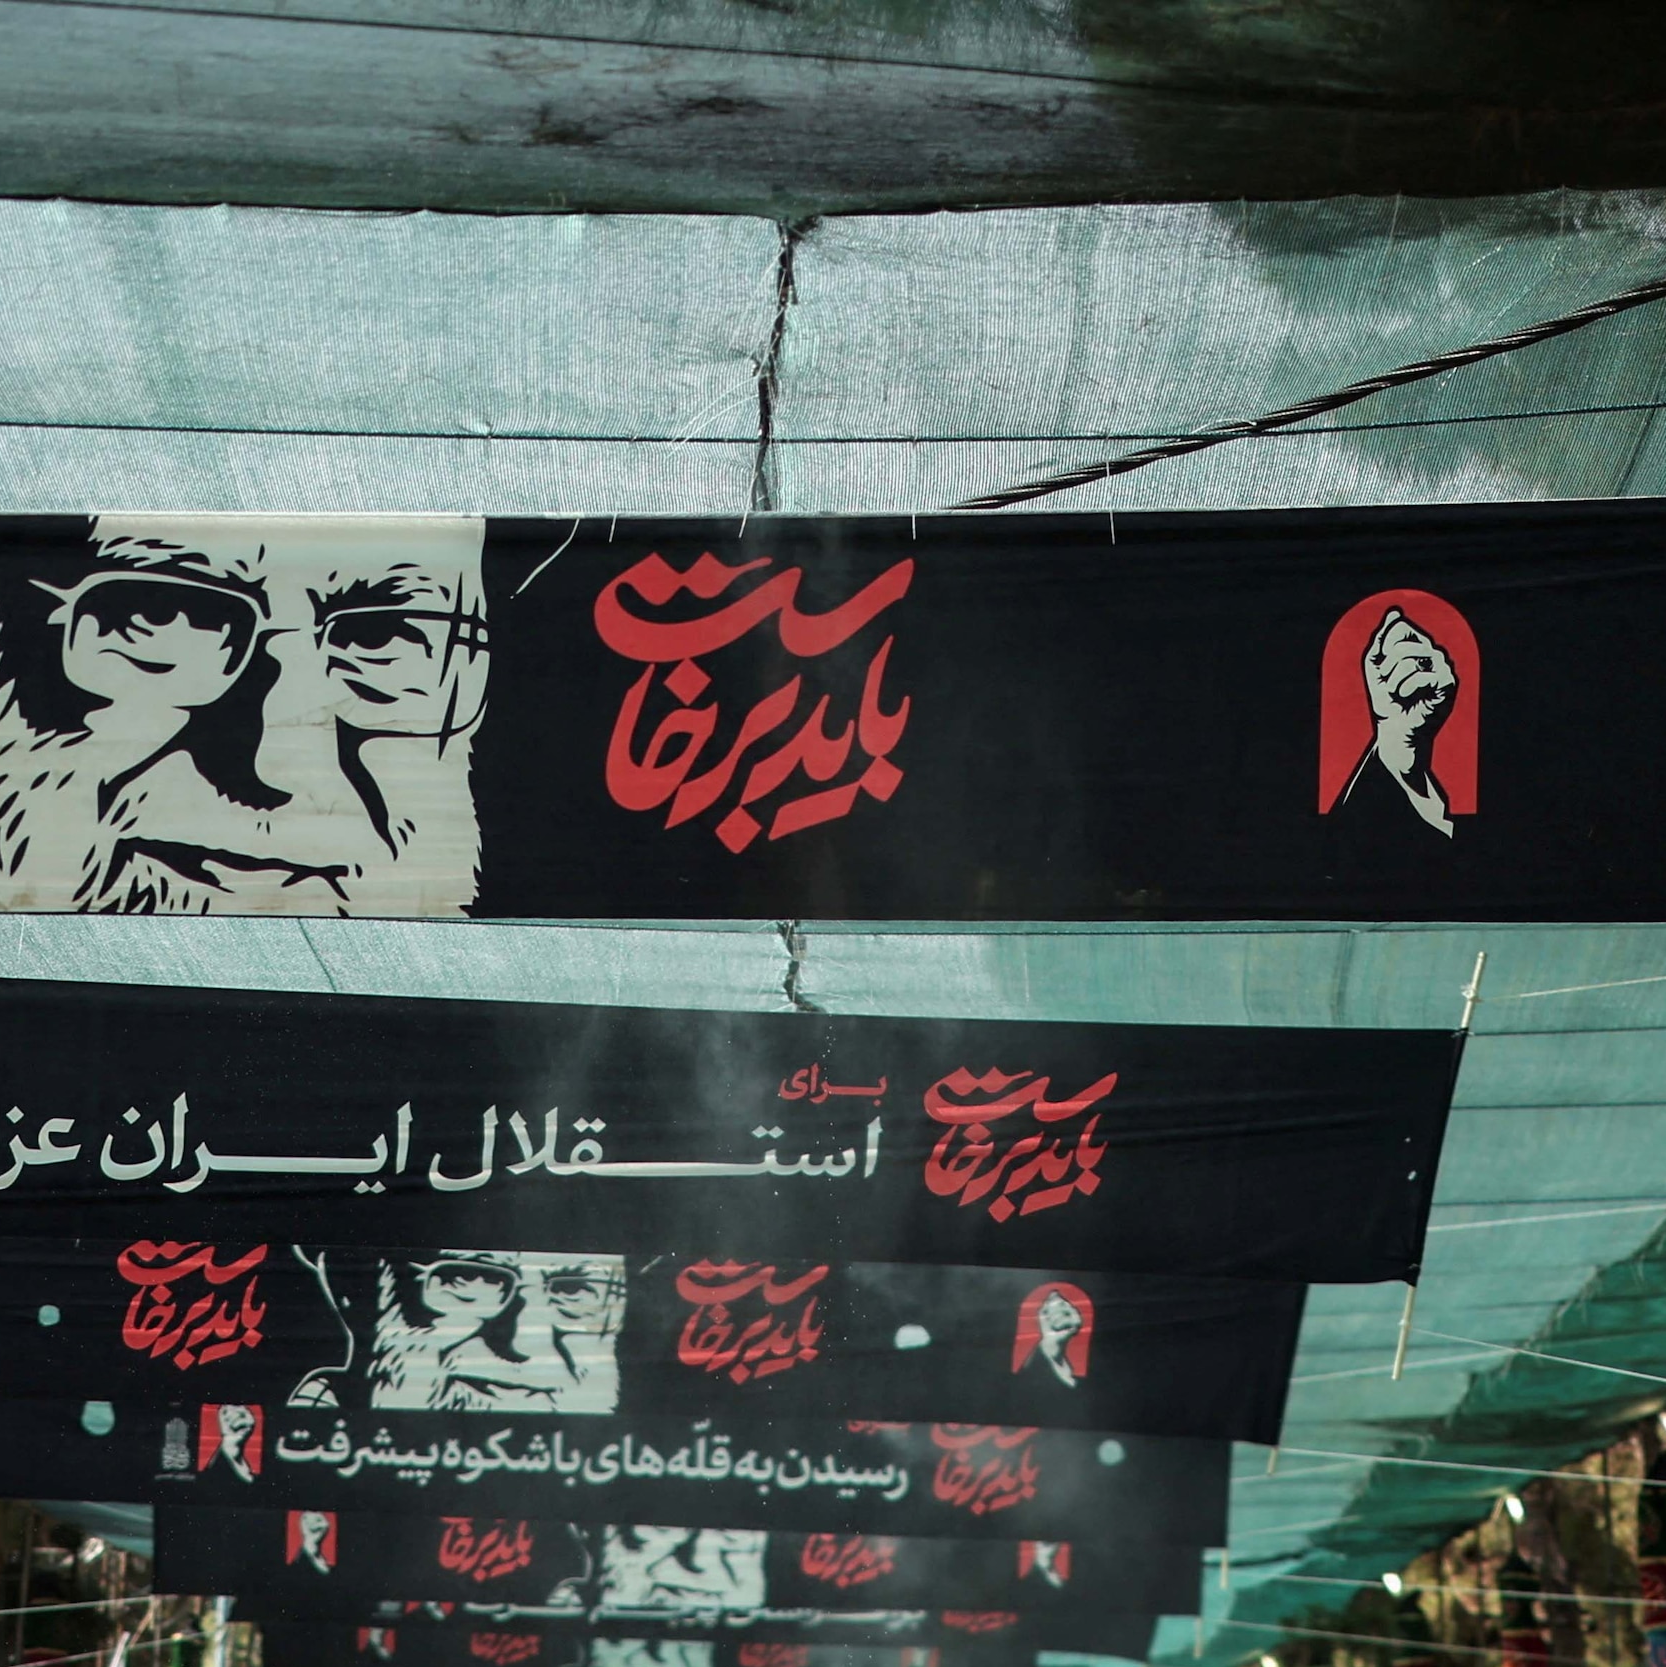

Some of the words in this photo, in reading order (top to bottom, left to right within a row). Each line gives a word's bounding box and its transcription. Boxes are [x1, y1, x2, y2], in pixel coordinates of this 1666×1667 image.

[778, 1062, 889, 1107] برای
[99, 1091, 413, 1195] ایران
[428, 1103, 884, 1192] استقلال
[274, 1418, 439, 1486] پیشرفت
[440, 1427, 581, 1487] باشکوه
[734, 1446, 773, 1495] به
[775, 1445, 910, 1500] رسیدن
